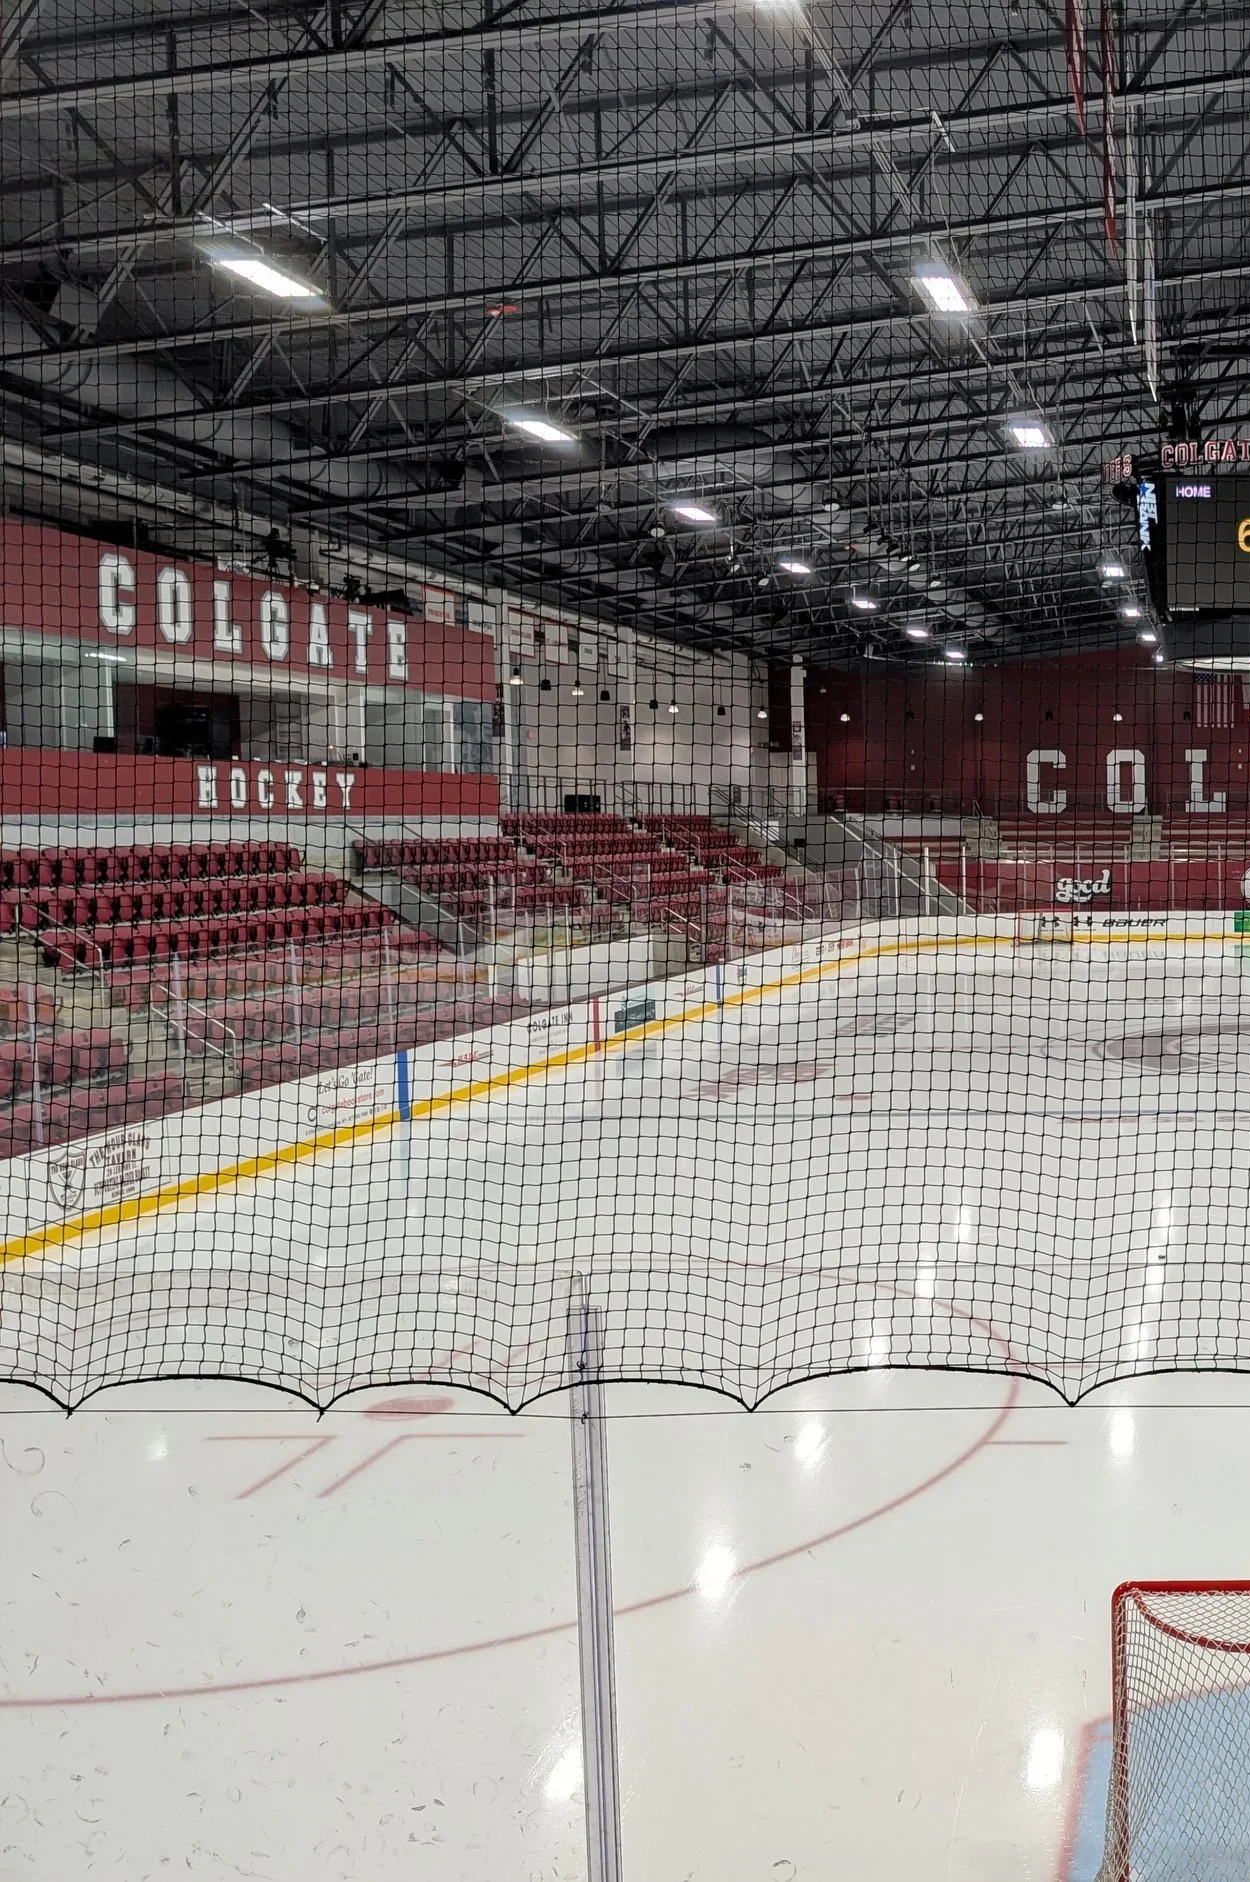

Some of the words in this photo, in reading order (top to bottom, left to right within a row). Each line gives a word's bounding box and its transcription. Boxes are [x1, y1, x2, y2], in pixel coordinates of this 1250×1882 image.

[1176, 485, 1212, 498] HOME
[98, 552, 409, 682] COLGATE
[197, 765, 355, 811] HOCKEY
[1055, 868, 1111, 903] good
[527, 1015, 559, 1034] COLGTE
[89, 1146, 105, 1168] THE
